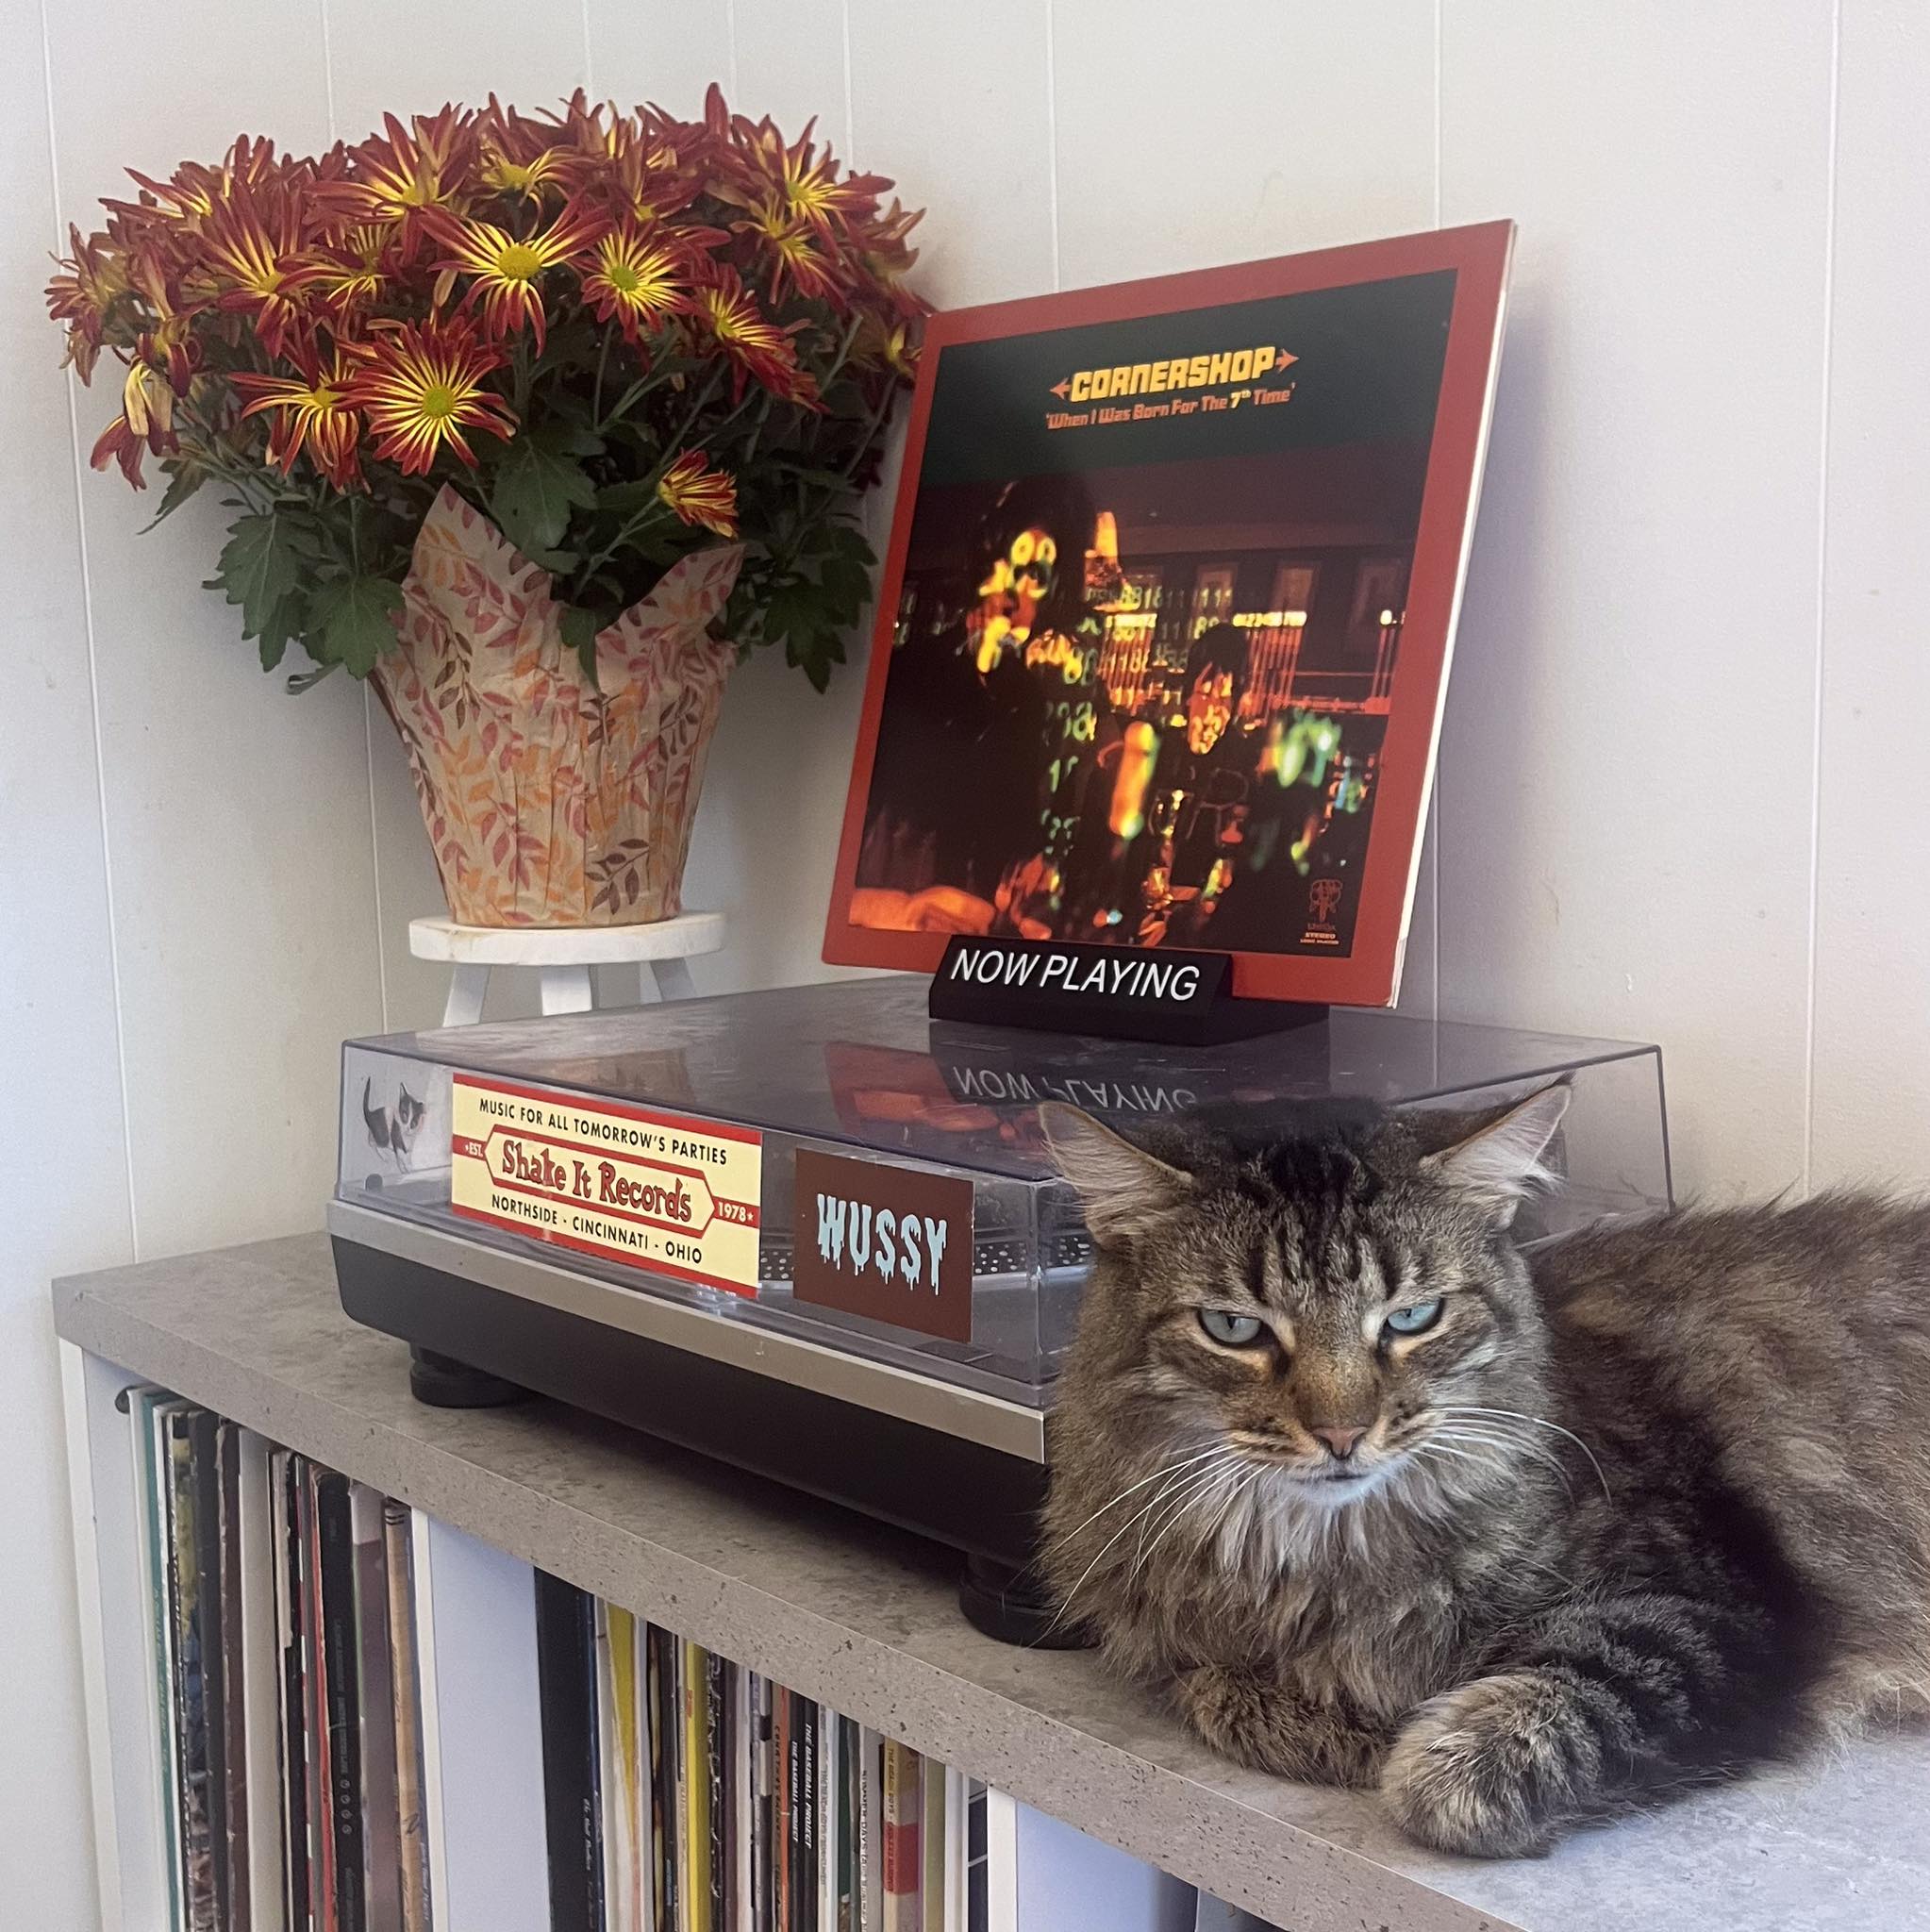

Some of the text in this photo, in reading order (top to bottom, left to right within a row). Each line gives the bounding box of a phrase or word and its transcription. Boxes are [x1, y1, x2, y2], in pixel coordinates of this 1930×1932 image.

[1070, 346, 1276, 403] CORNERSHOP
[1090, 409, 1097, 425] I
[1099, 407, 1132, 425] Was
[1133, 404, 1170, 421] Born
[1172, 399, 1200, 416] For
[1201, 395, 1227, 411] The
[950, 949, 1201, 1002] NOW PLAYING
[480, 1098, 727, 1166] MUSIC FOR ALL TOMORROW'S PARTIES
[502, 1140, 692, 1224] Shake It Records
[718, 1201, 747, 1224] 1978
[491, 1194, 704, 1265] NORTHSIDE CINCINNATI OHIO
[817, 1193, 948, 1296] WUSSY
[805, 1723, 813, 1850] THE BASEBALL PROJECT
